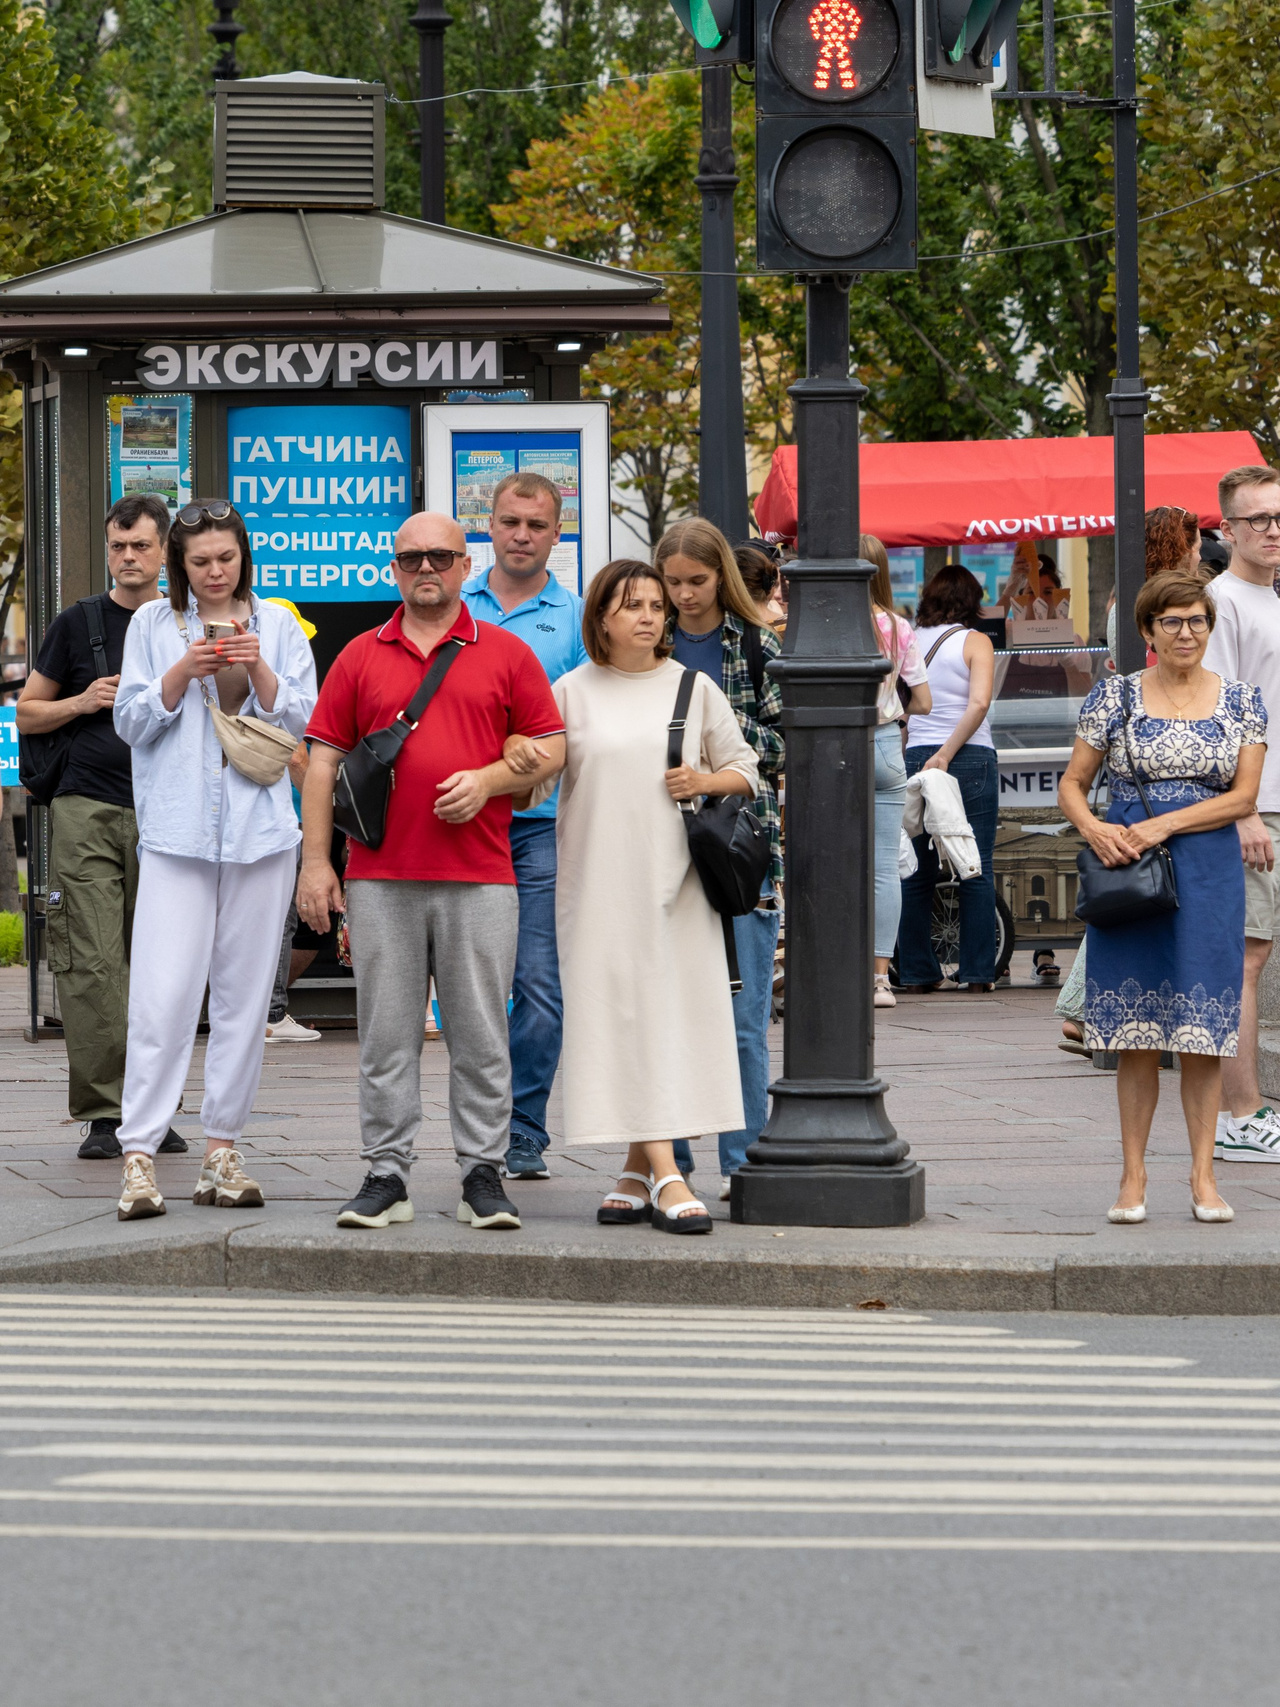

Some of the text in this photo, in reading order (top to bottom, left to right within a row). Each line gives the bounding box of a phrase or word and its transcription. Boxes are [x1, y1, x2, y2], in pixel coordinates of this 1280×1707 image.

[143, 341, 497, 386] ЭКСКУРСИИ
[233, 436, 404, 463] ГАТЧИНА
[233, 477, 405, 505] ПУШКИН
[247, 532, 396, 554] РОНШТАД
[1000, 770, 1108, 793] NTEA
